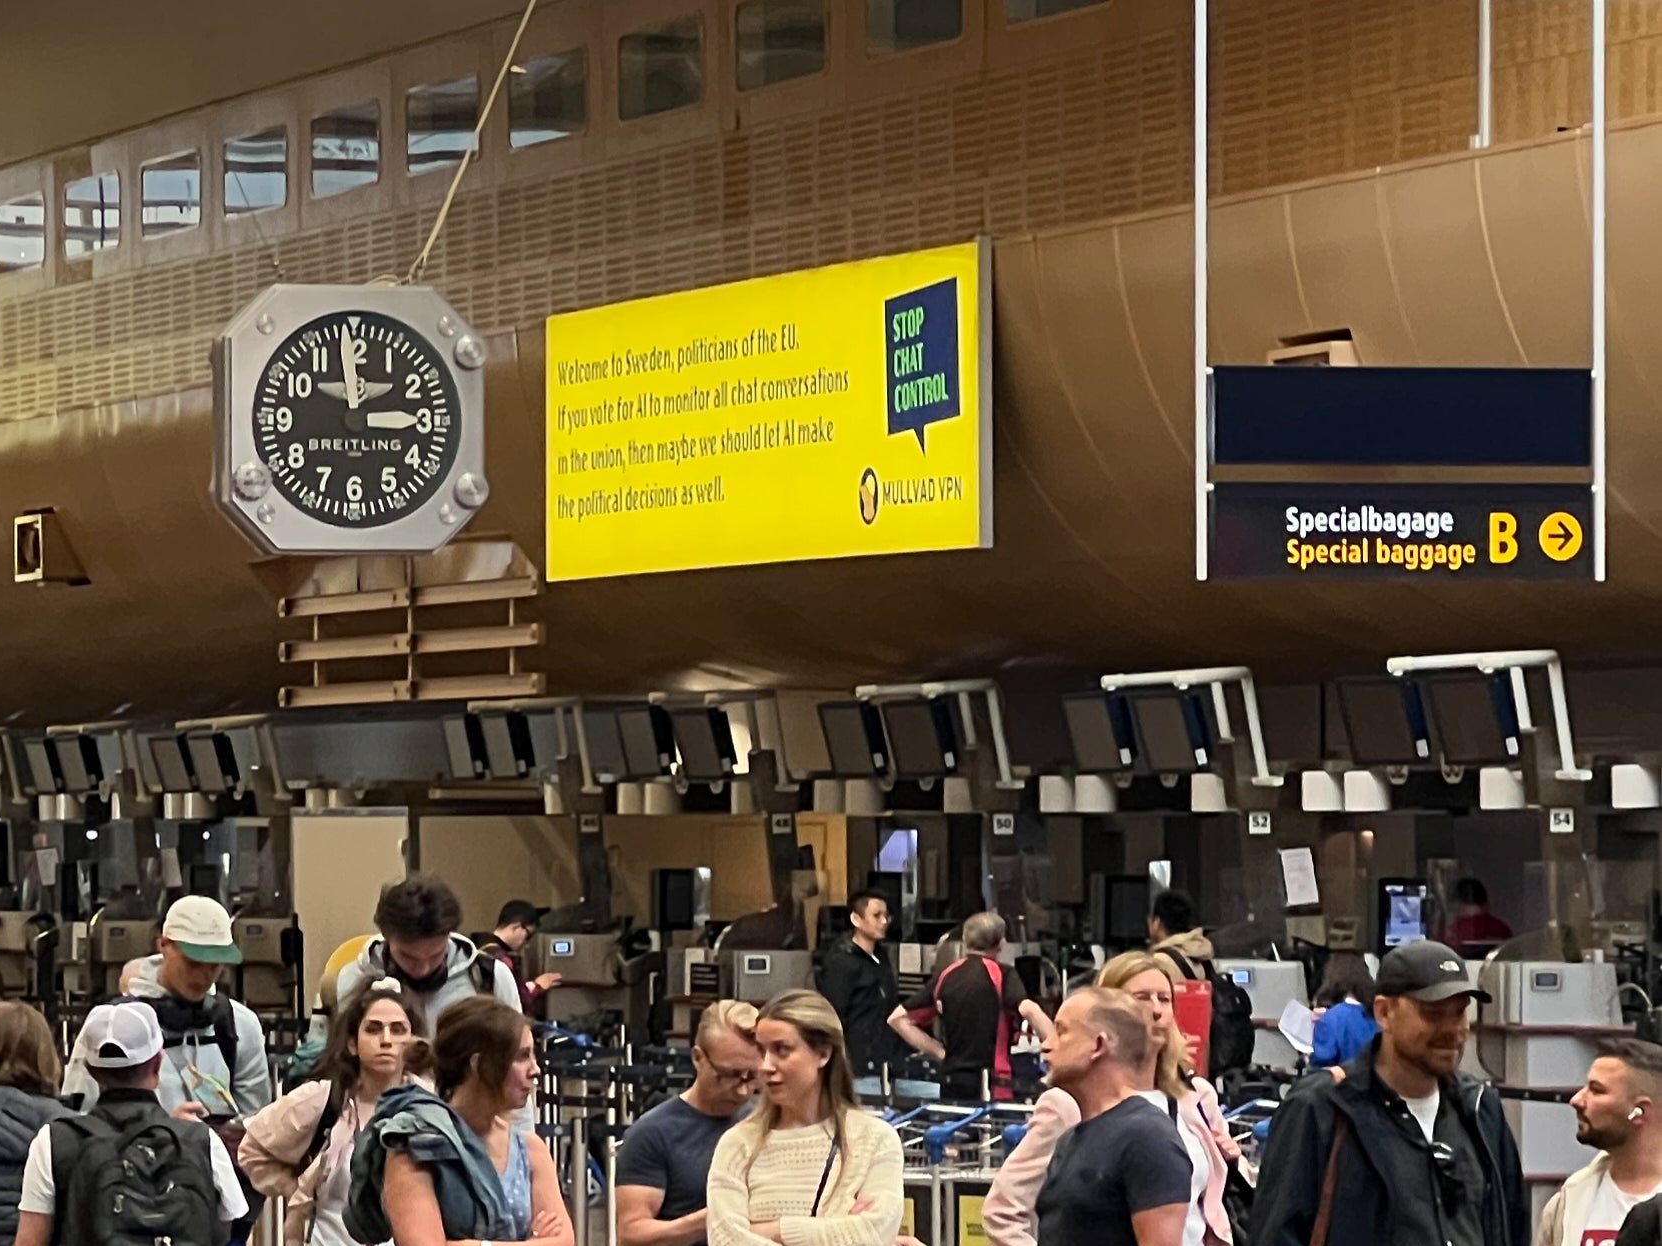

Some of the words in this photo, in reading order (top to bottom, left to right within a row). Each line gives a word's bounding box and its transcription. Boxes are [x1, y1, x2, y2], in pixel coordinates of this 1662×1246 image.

[893, 307, 925, 342] STOP
[312, 346, 328, 373] 11
[385, 346, 393, 374] 1
[558, 359, 608, 387] Welcome
[611, 353, 623, 377] to
[625, 346, 675, 376] Sweden,
[677, 336, 739, 373] politicians
[742, 330, 756, 357] of
[758, 328, 778, 354] the
[781, 323, 800, 351] EU.
[893, 342, 924, 378] CHAT
[287, 372, 312, 399] 10
[405, 373, 422, 399] 2
[894, 373, 949, 413] CONTROL
[558, 405, 566, 430] If
[568, 410, 588, 435] you
[590, 399, 614, 426] vote
[617, 396, 634, 421] for
[637, 393, 648, 418] AI
[649, 393, 661, 417] to
[663, 386, 711, 414] monitor
[714, 381, 728, 408] all
[731, 376, 757, 407] chat
[761, 367, 849, 401] conversations
[276, 406, 293, 433] 9
[415, 407, 432, 434] 3
[288, 442, 304, 469] 8
[308, 438, 402, 451] BREITLING
[404, 443, 421, 469] 4
[558, 451, 568, 475] in
[571, 448, 588, 473] the
[591, 443, 626, 473] union,
[628, 439, 654, 465] then
[657, 433, 696, 466] maybe
[699, 437, 717, 457] we
[721, 423, 761, 454] should
[764, 421, 780, 448] let
[783, 419, 795, 446] AI
[798, 416, 834, 445] make
[315, 466, 333, 493] 7
[346, 475, 363, 502] 6
[380, 466, 398, 493] 5
[882, 478, 935, 506] MULLVAD
[938, 476, 962, 501] VPN
[558, 493, 575, 520] the
[578, 487, 623, 523] political
[625, 482, 678, 512] decisions
[681, 483, 693, 506] as
[695, 475, 725, 503] well.
[1286, 505, 1455, 538] Specialbagage
[1489, 512, 1518, 564] B
[1287, 537, 1369, 570] Special
[1376, 537, 1477, 571] baggage
[1252, 816, 1268, 828] 52
[1553, 813, 1570, 826] 54
